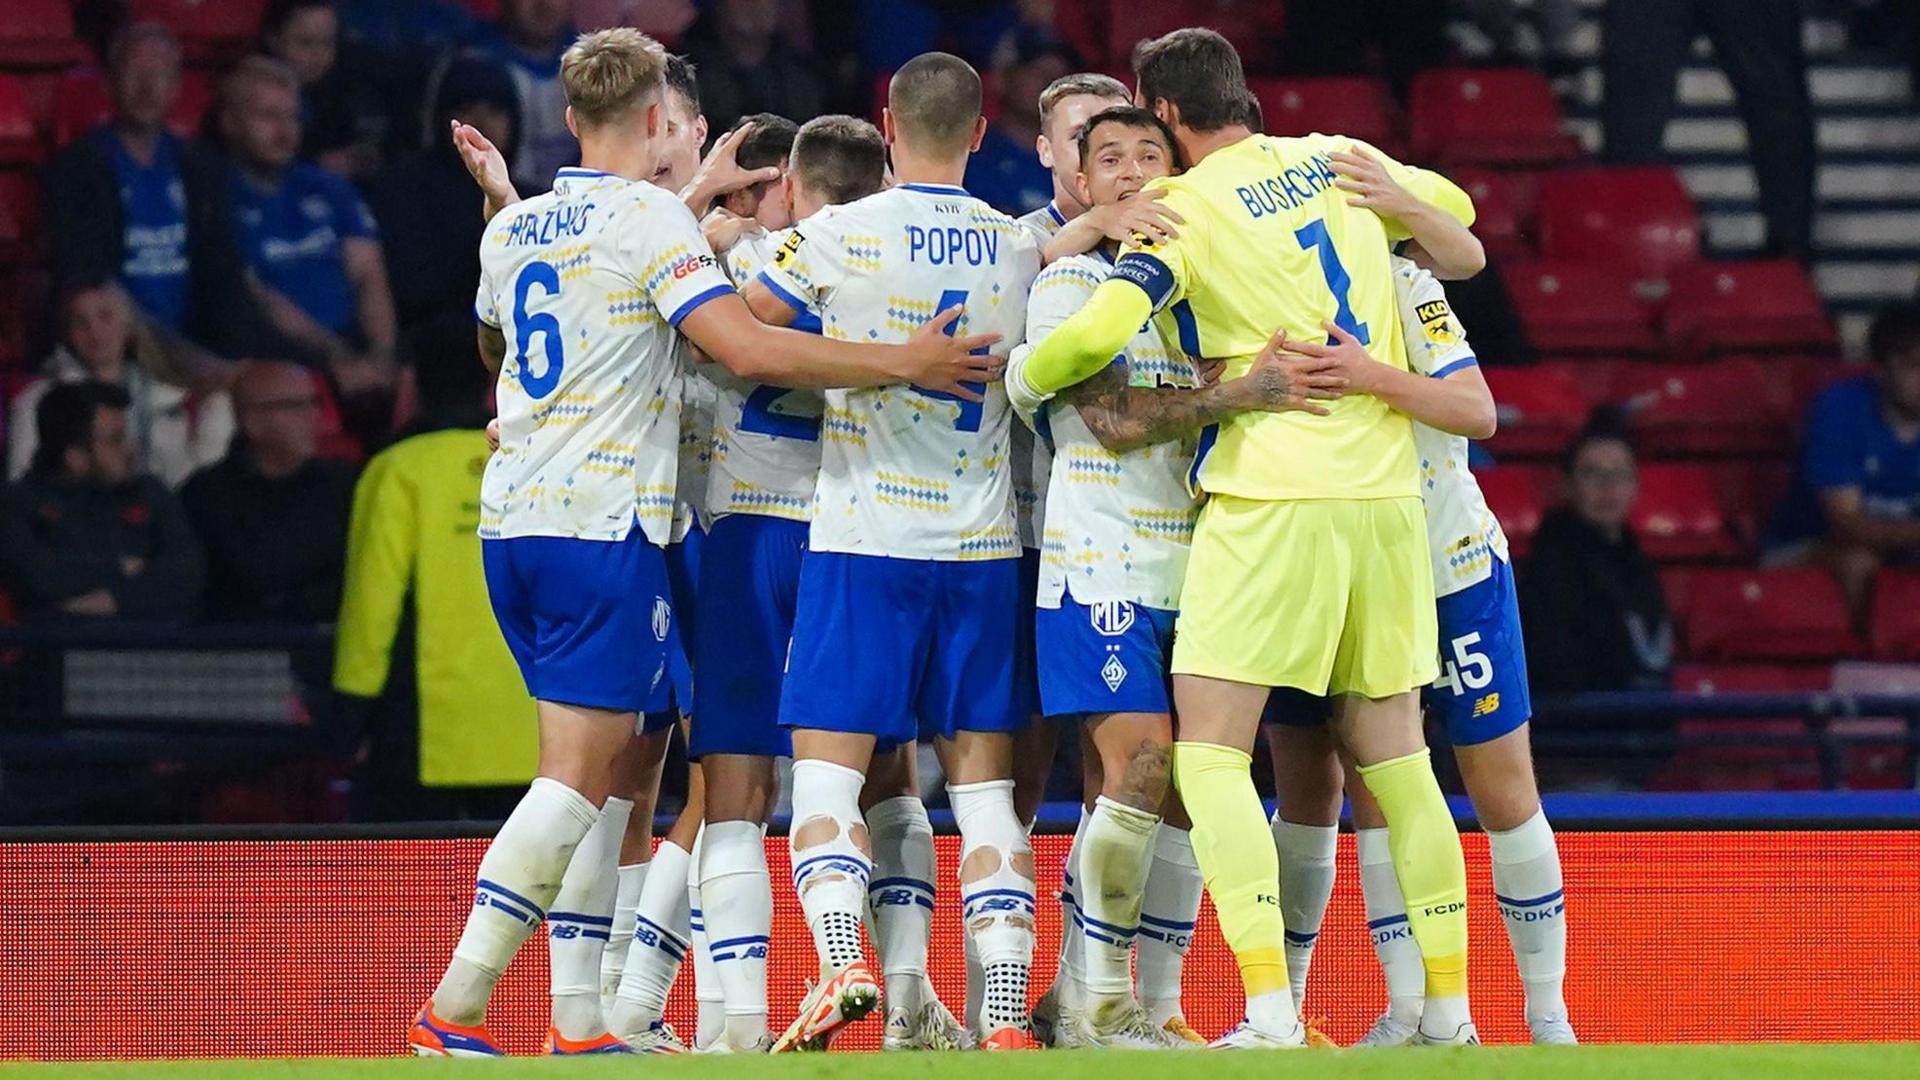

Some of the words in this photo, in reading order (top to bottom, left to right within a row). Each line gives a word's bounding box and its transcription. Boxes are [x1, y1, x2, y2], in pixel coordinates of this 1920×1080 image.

[1236, 152, 1337, 218] BUSHCHA
[910, 225, 998, 266] POPOV
[1294, 217, 1371, 346] 1
[513, 260, 564, 400] 6
[1091, 600, 1134, 635] MG
